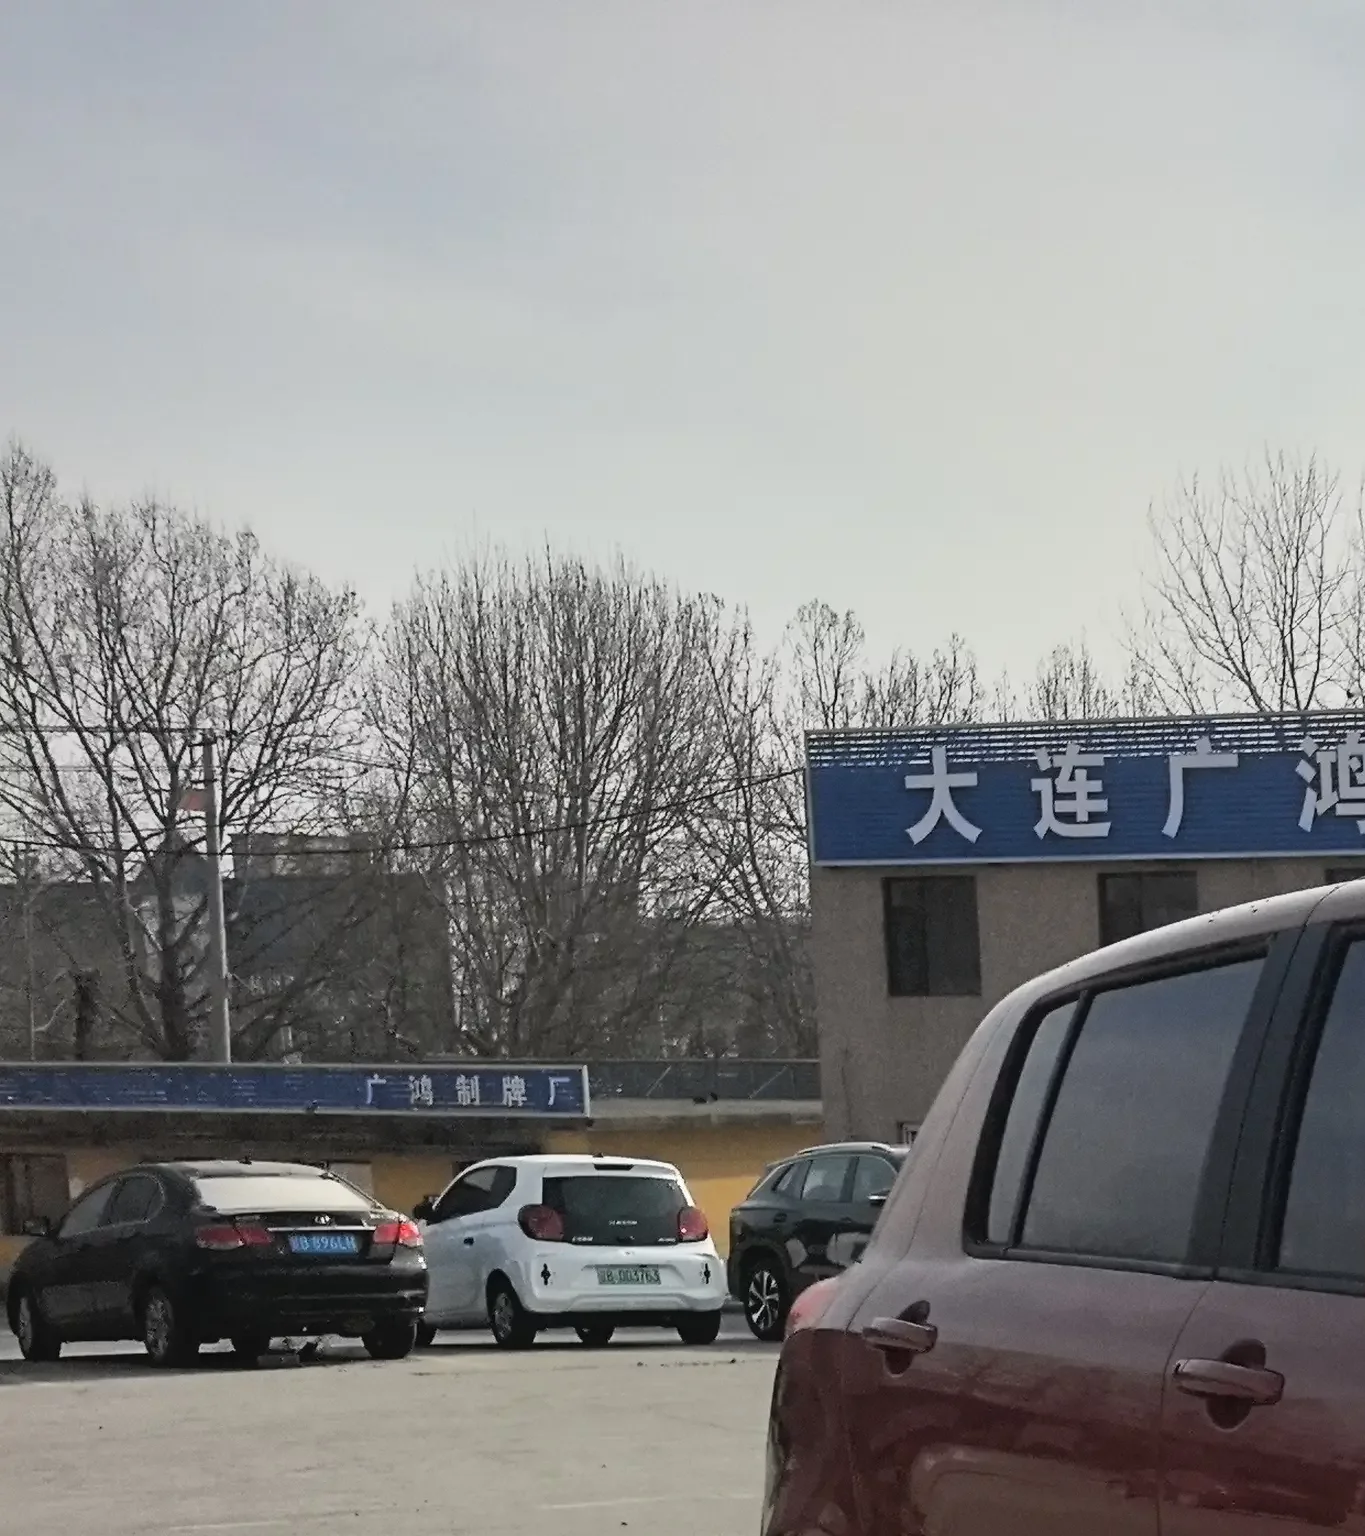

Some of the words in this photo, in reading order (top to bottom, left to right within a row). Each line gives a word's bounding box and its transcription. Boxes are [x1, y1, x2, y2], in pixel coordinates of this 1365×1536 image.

[366, 1073, 571, 1107] 广鸿制牌厂
